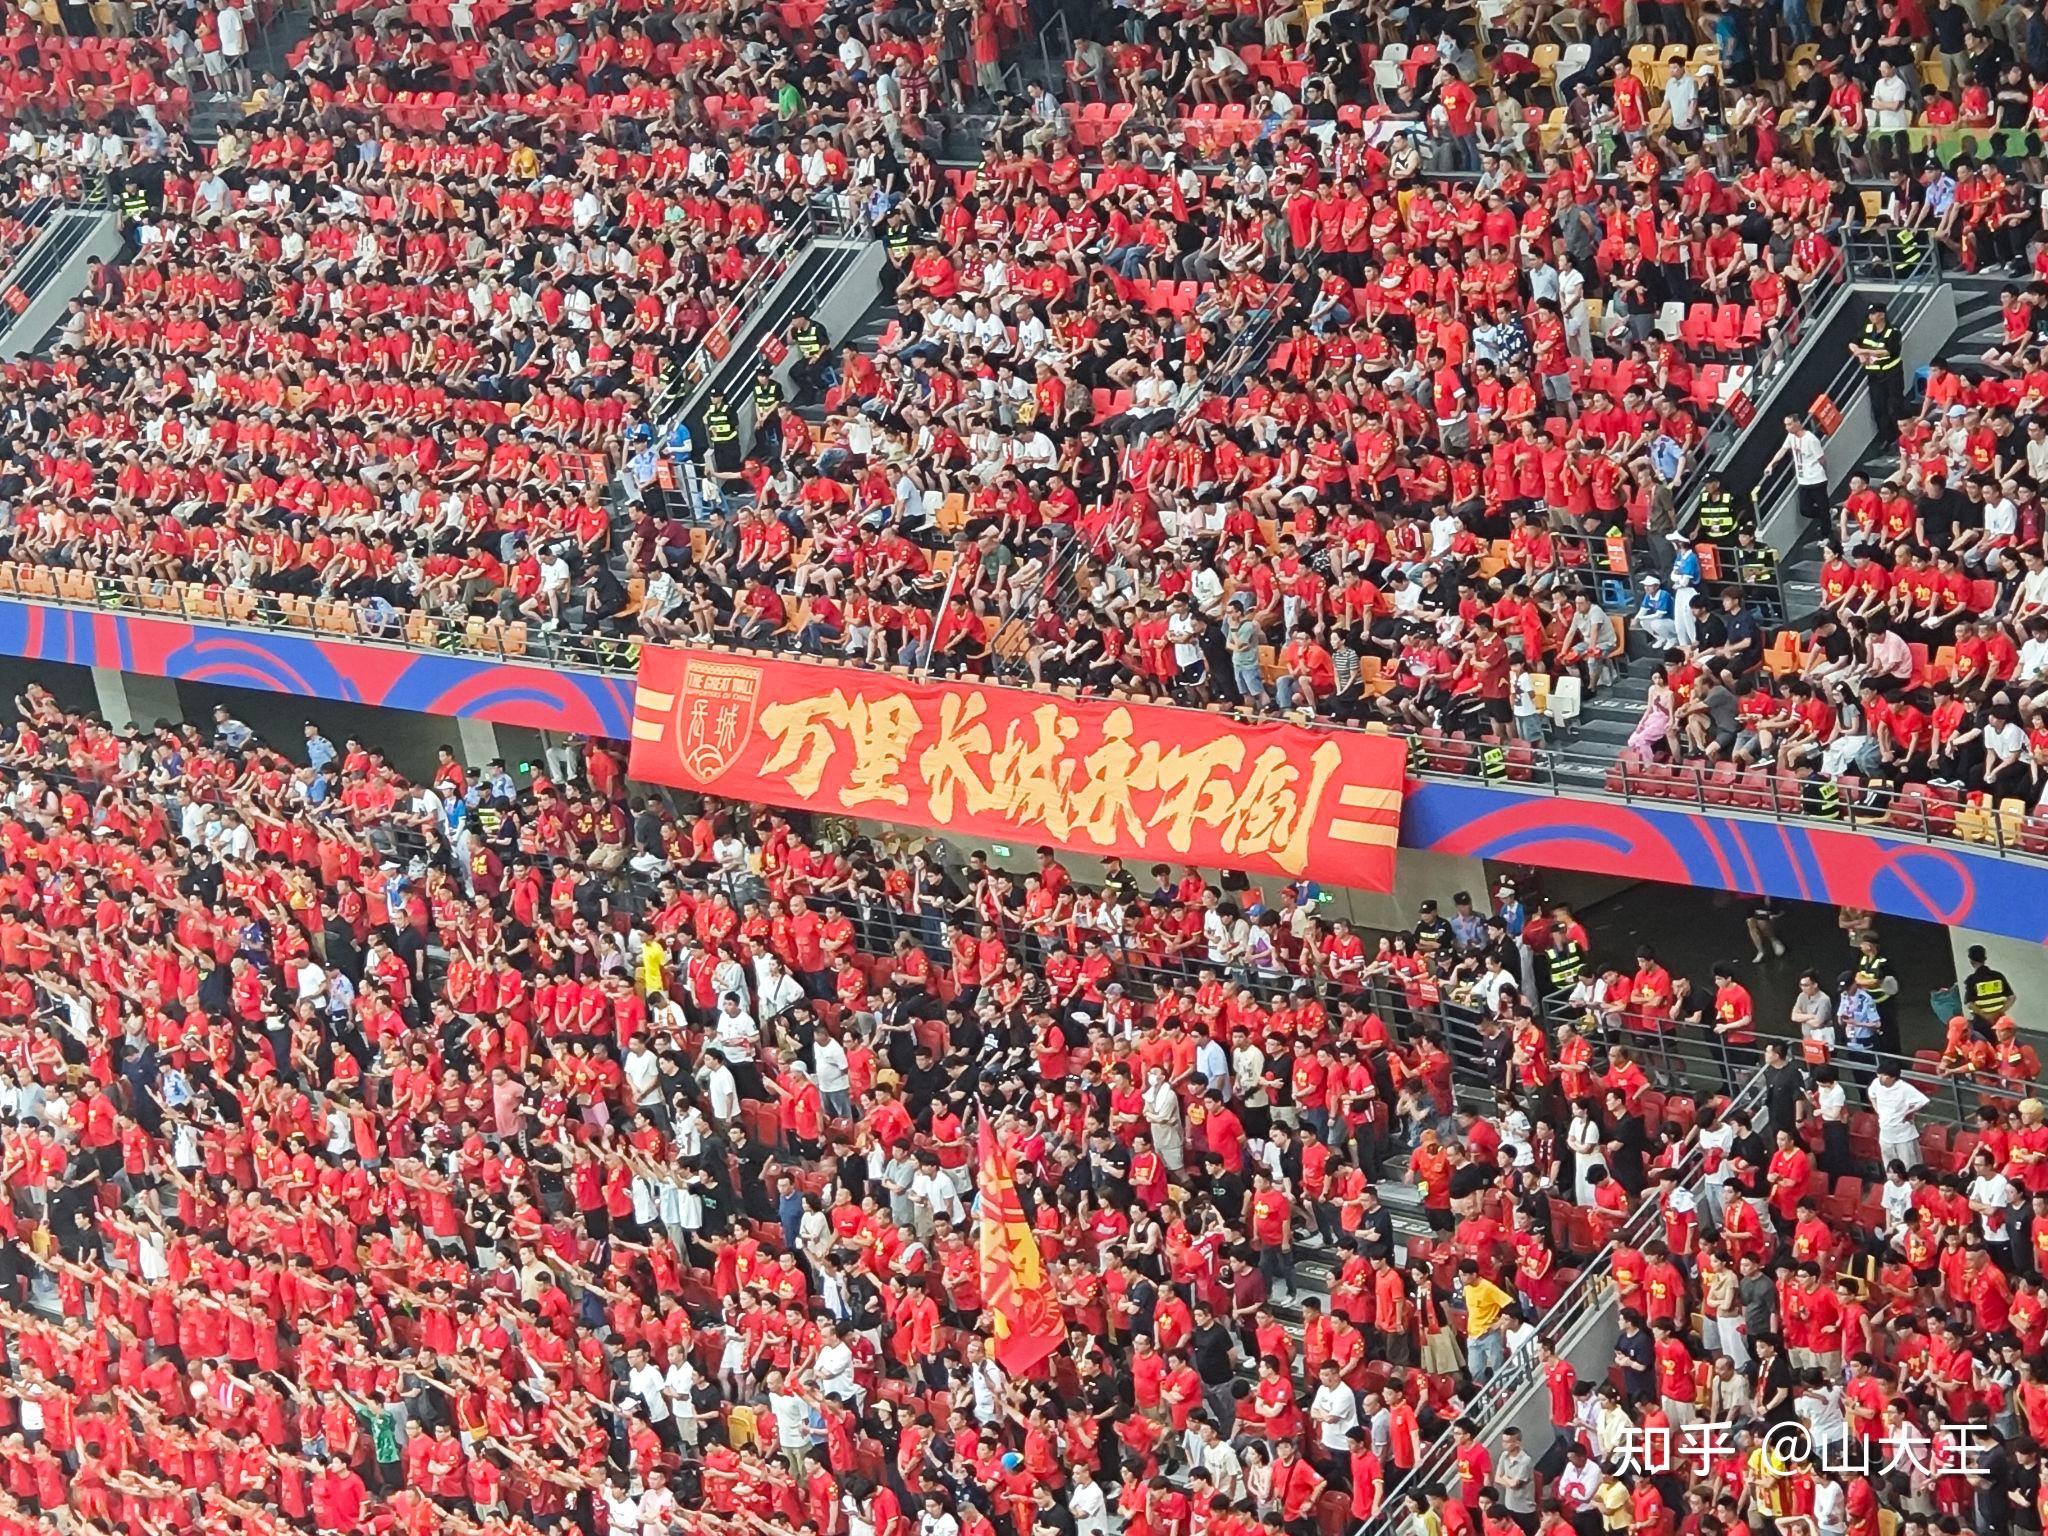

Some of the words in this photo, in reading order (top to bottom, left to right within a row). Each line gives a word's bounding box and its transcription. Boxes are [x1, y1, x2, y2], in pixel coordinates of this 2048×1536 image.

[687, 672, 705, 689] THE
[704, 675, 732, 692] GREAT
[732, 678, 756, 695] WALL
[757, 688, 1342, 876] 万里长城永不倒
